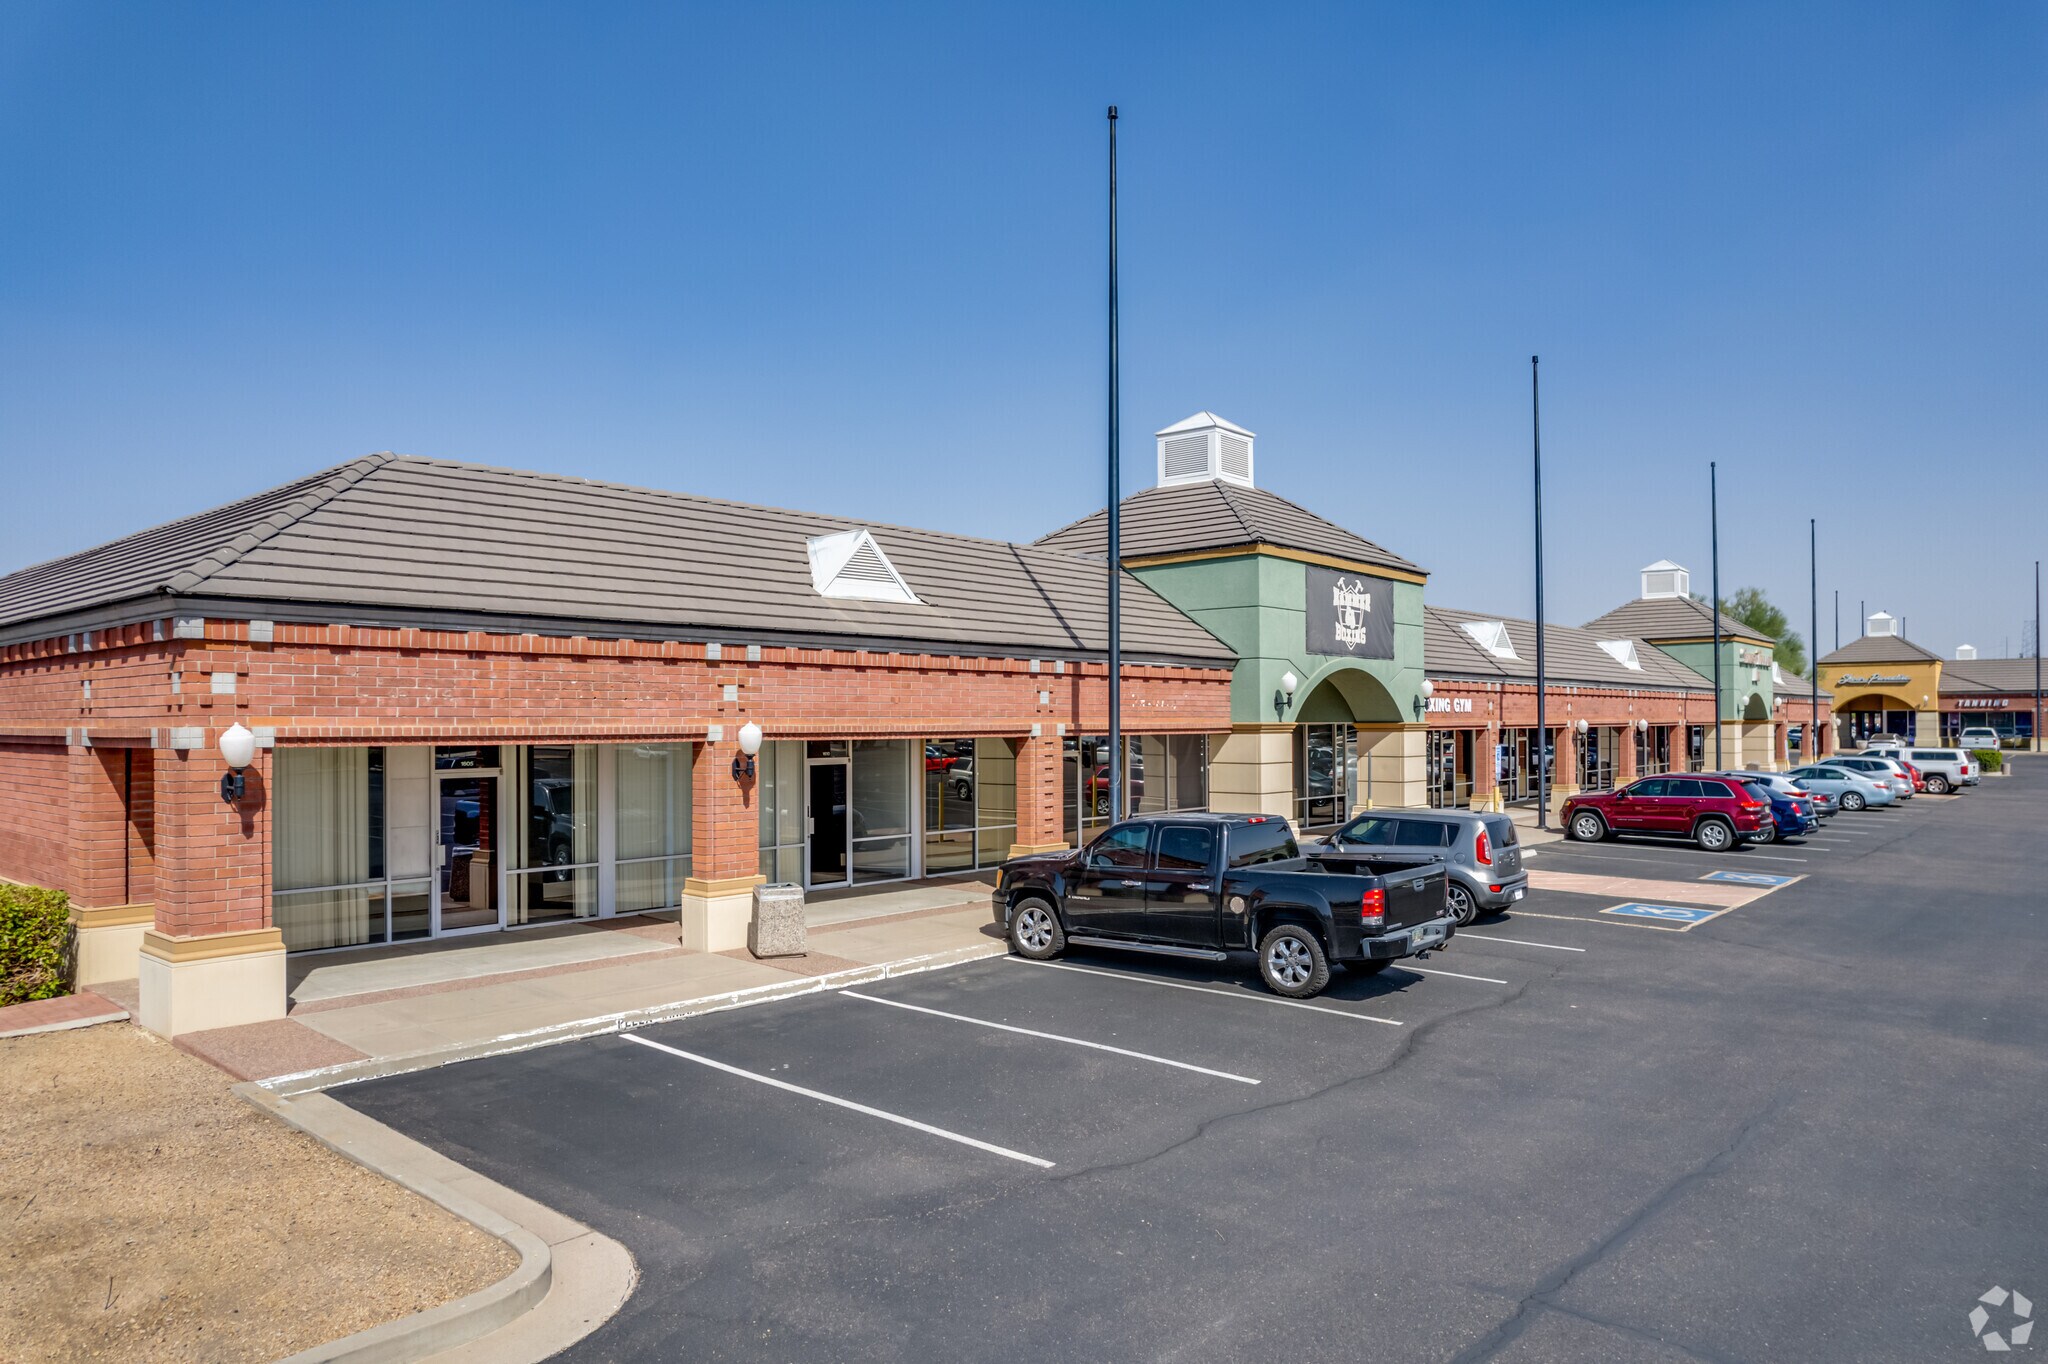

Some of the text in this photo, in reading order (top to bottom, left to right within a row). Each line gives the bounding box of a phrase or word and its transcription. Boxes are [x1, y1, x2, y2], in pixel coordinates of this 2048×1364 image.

[1335, 621, 1366, 644] BOXING
[1454, 698, 1472, 713] GYM
[1958, 699, 2009, 707] TANNING
